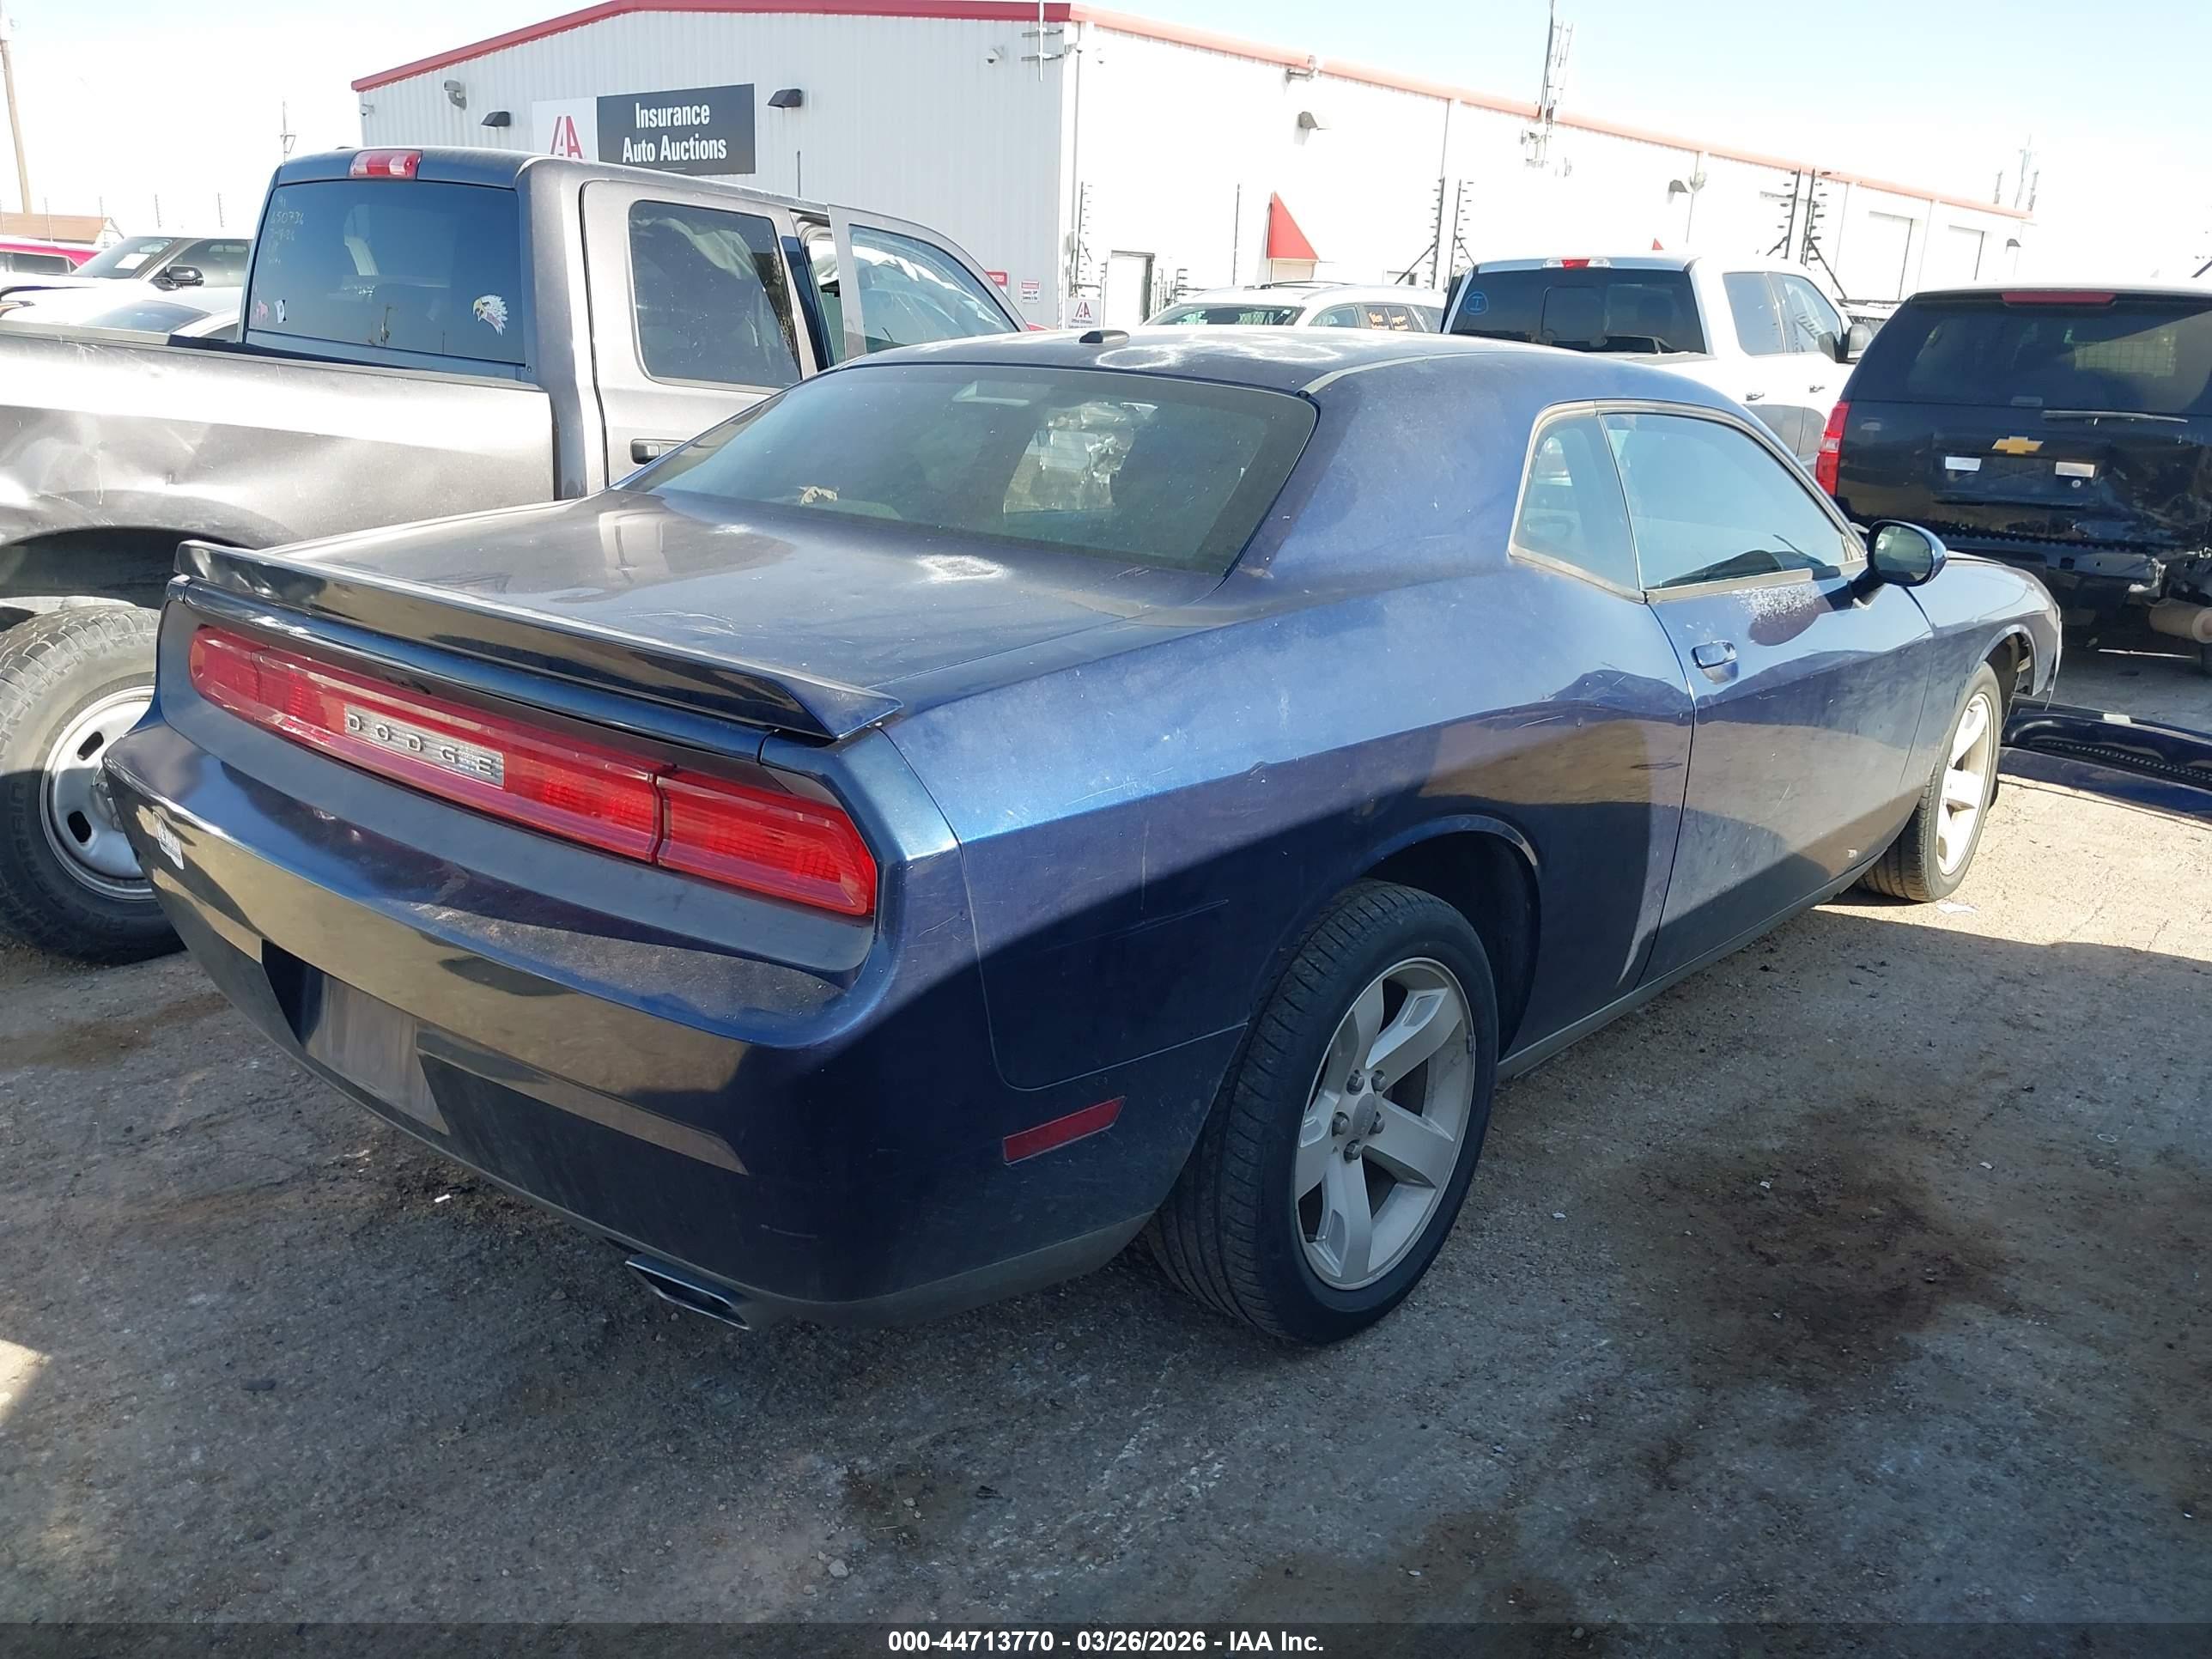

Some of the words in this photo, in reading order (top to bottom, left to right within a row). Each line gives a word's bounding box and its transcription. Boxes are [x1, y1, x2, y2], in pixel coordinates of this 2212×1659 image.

[635, 101, 710, 130] Insurance
[622, 137, 657, 163] Auto
[659, 133, 727, 162] Auctions
[347, 713, 495, 777] DODGE
